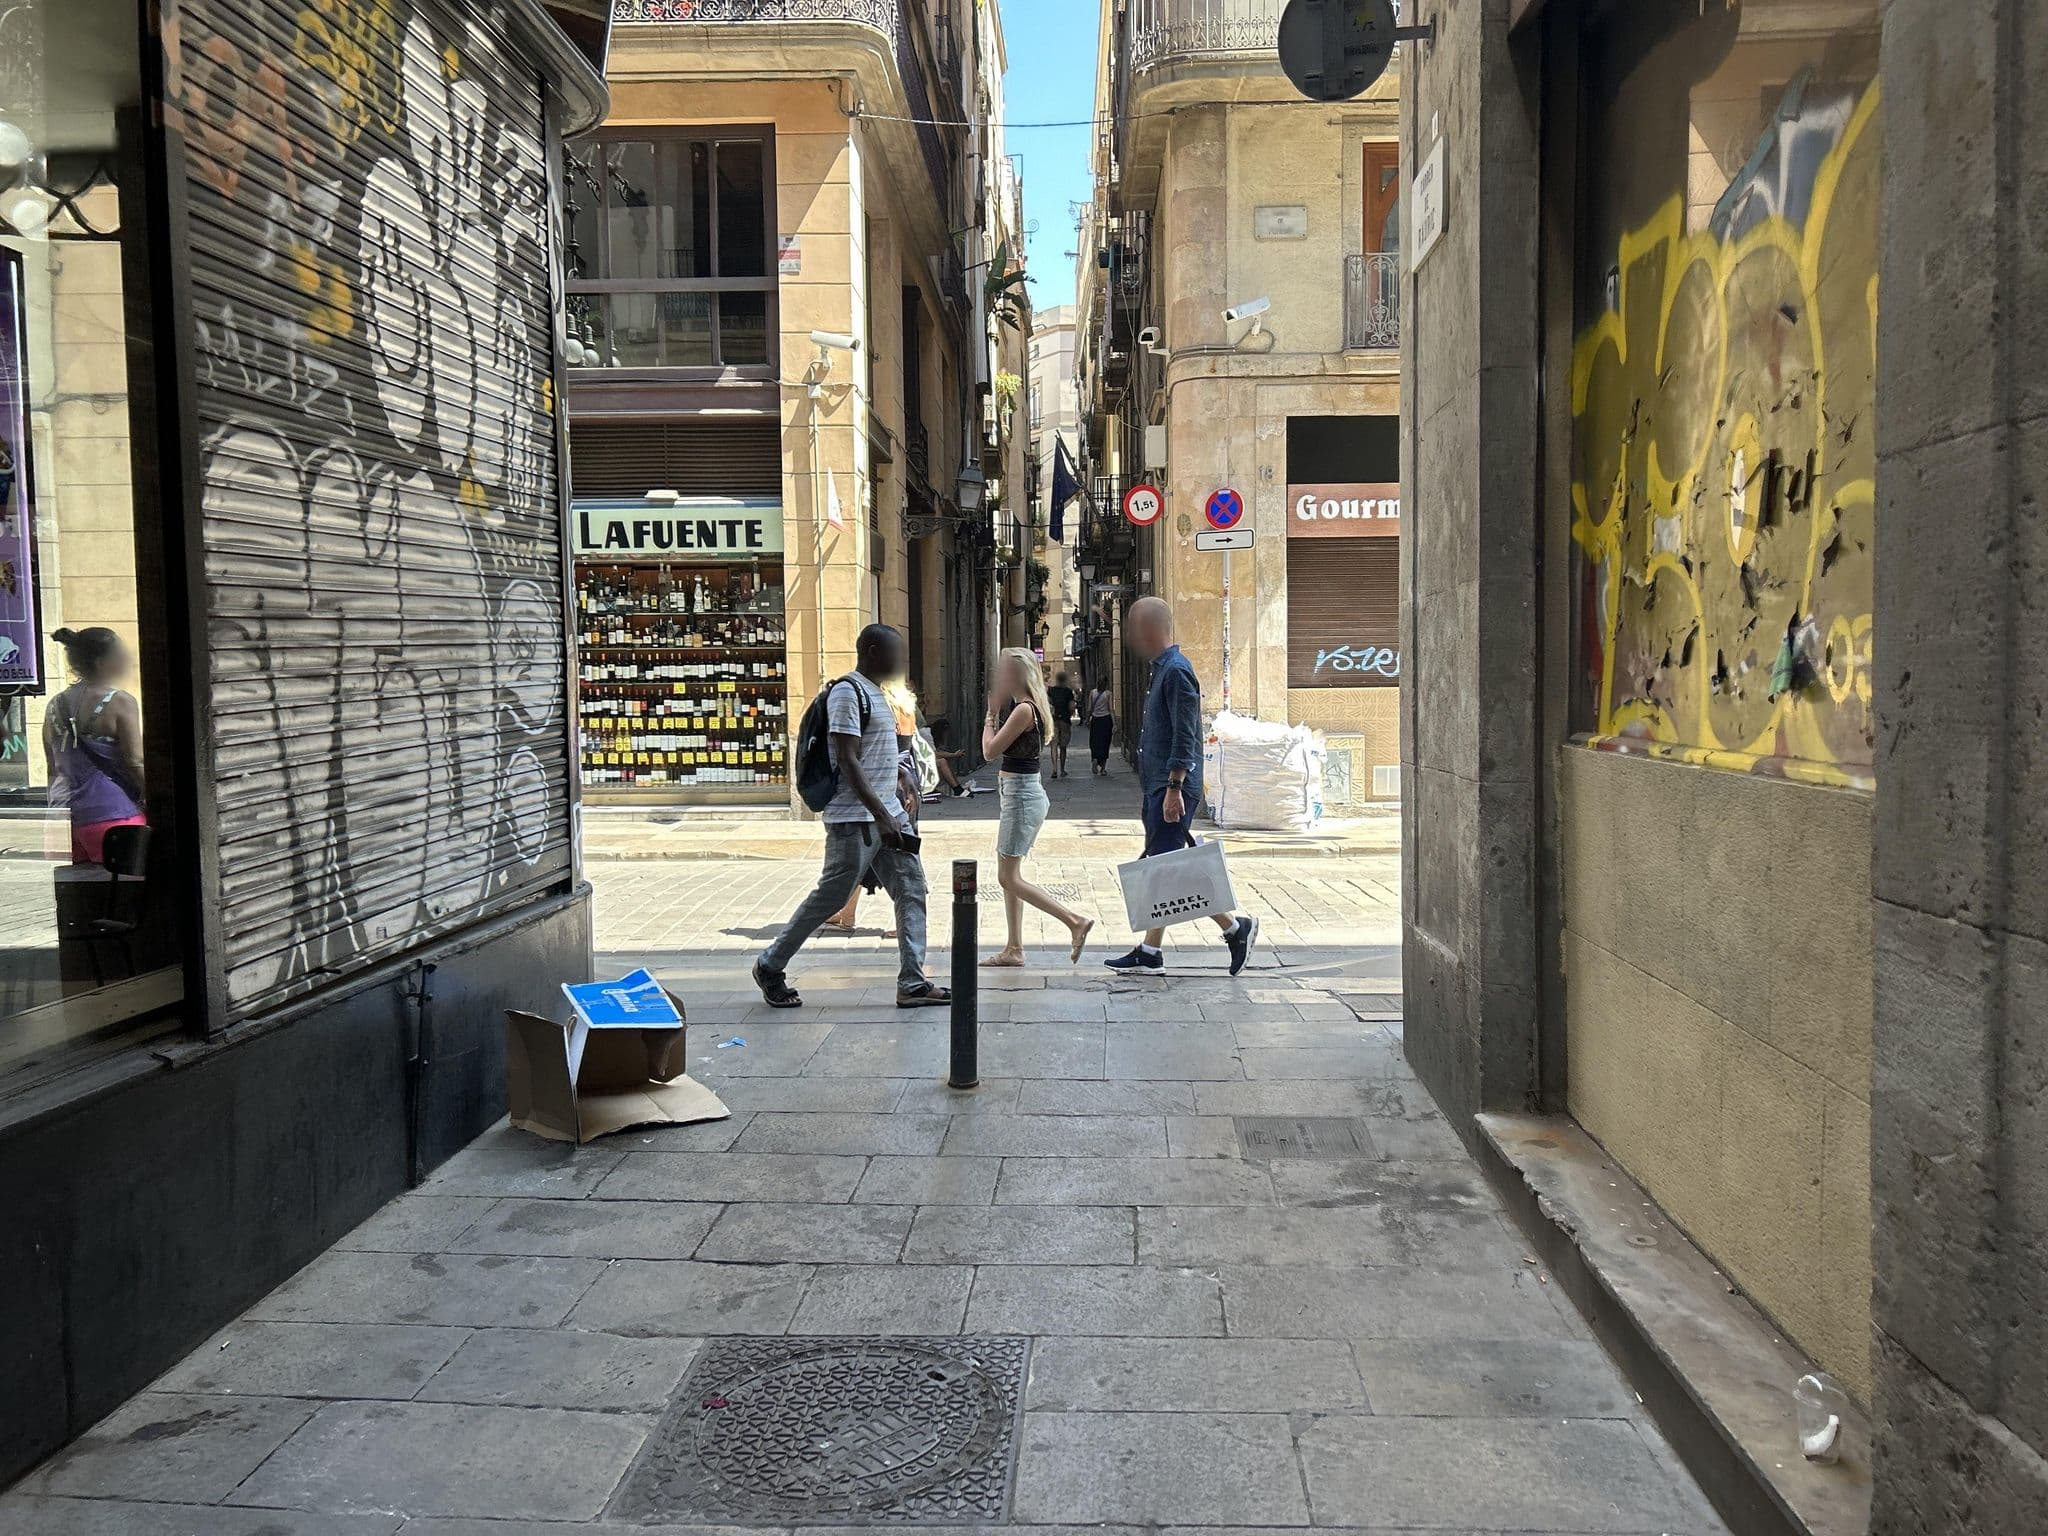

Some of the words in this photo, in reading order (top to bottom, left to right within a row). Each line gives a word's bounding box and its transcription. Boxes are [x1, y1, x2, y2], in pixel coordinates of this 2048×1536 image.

[1133, 499, 1155, 512] 1,5t
[580, 511, 763, 549] LAFUENTE
[1151, 901, 1210, 919] MARANT
[1154, 894, 1204, 910] ISABEL
